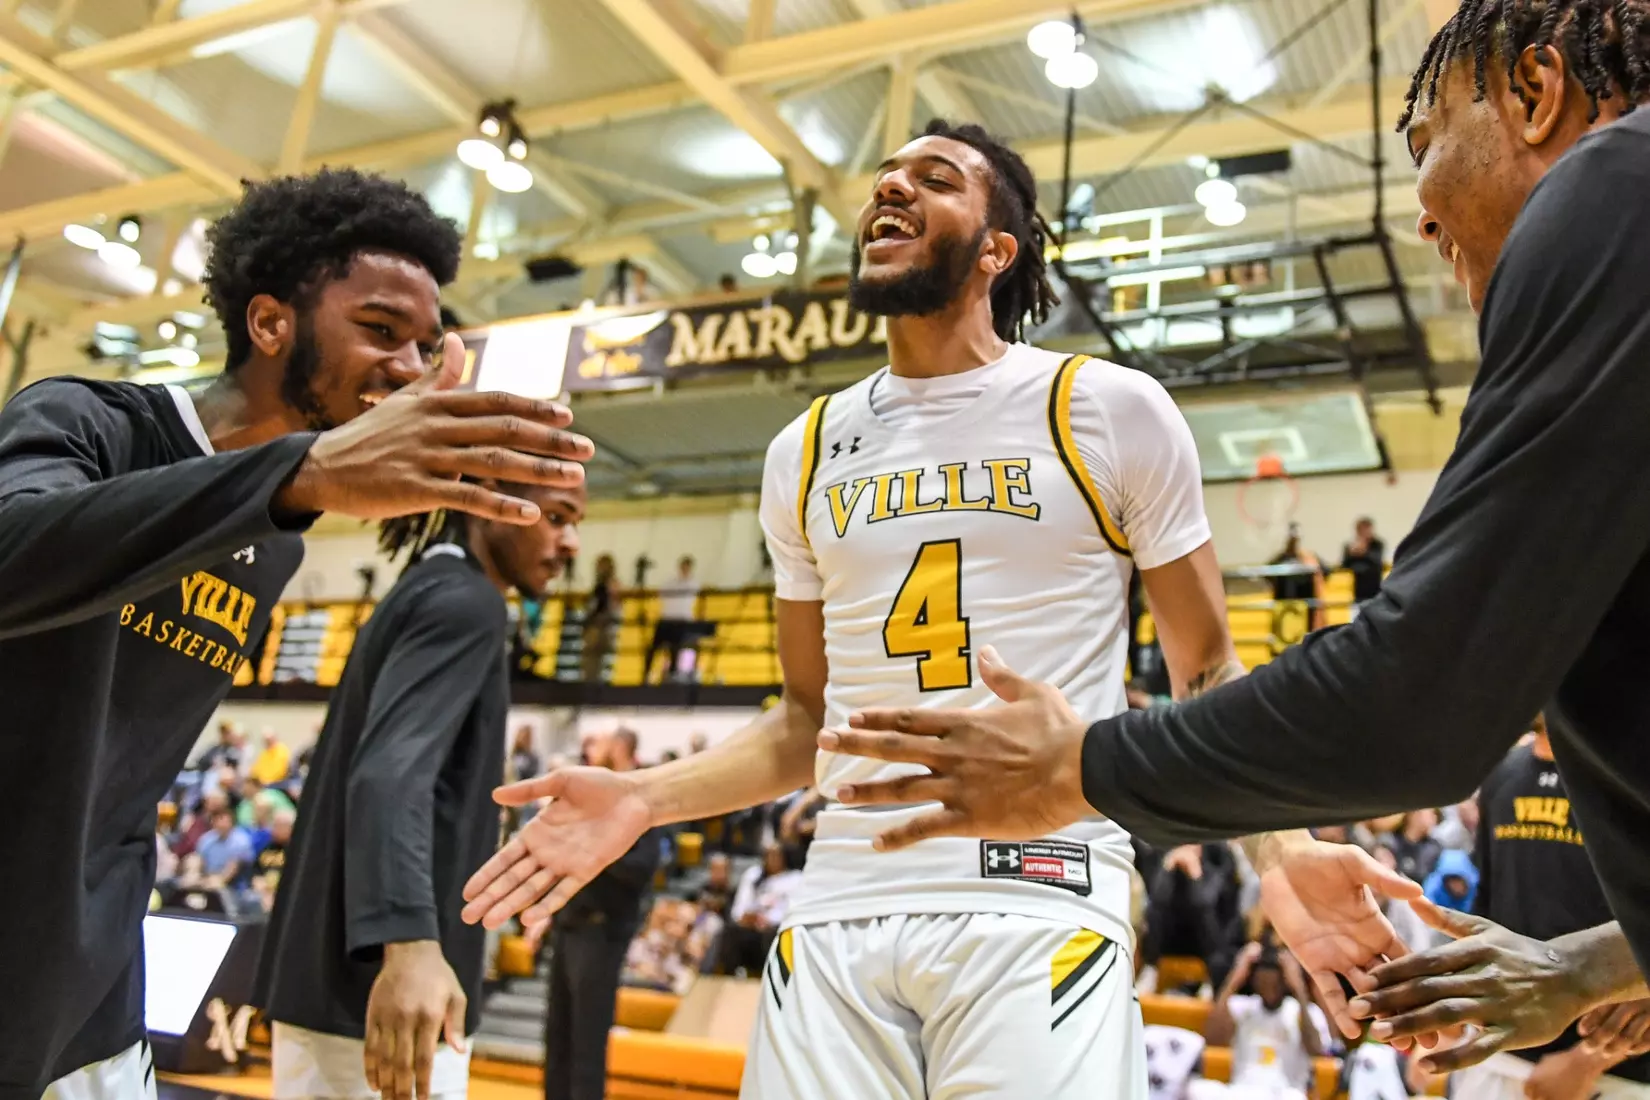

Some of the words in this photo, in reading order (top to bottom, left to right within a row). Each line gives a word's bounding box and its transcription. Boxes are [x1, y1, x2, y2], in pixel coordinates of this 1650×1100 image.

[825, 457, 1041, 538] VILLE
[181, 570, 257, 648] VILLE
[882, 538, 972, 693] 4
[1513, 796, 1569, 828] VILLE
[1025, 862, 1063, 874] AUTHENTIC
